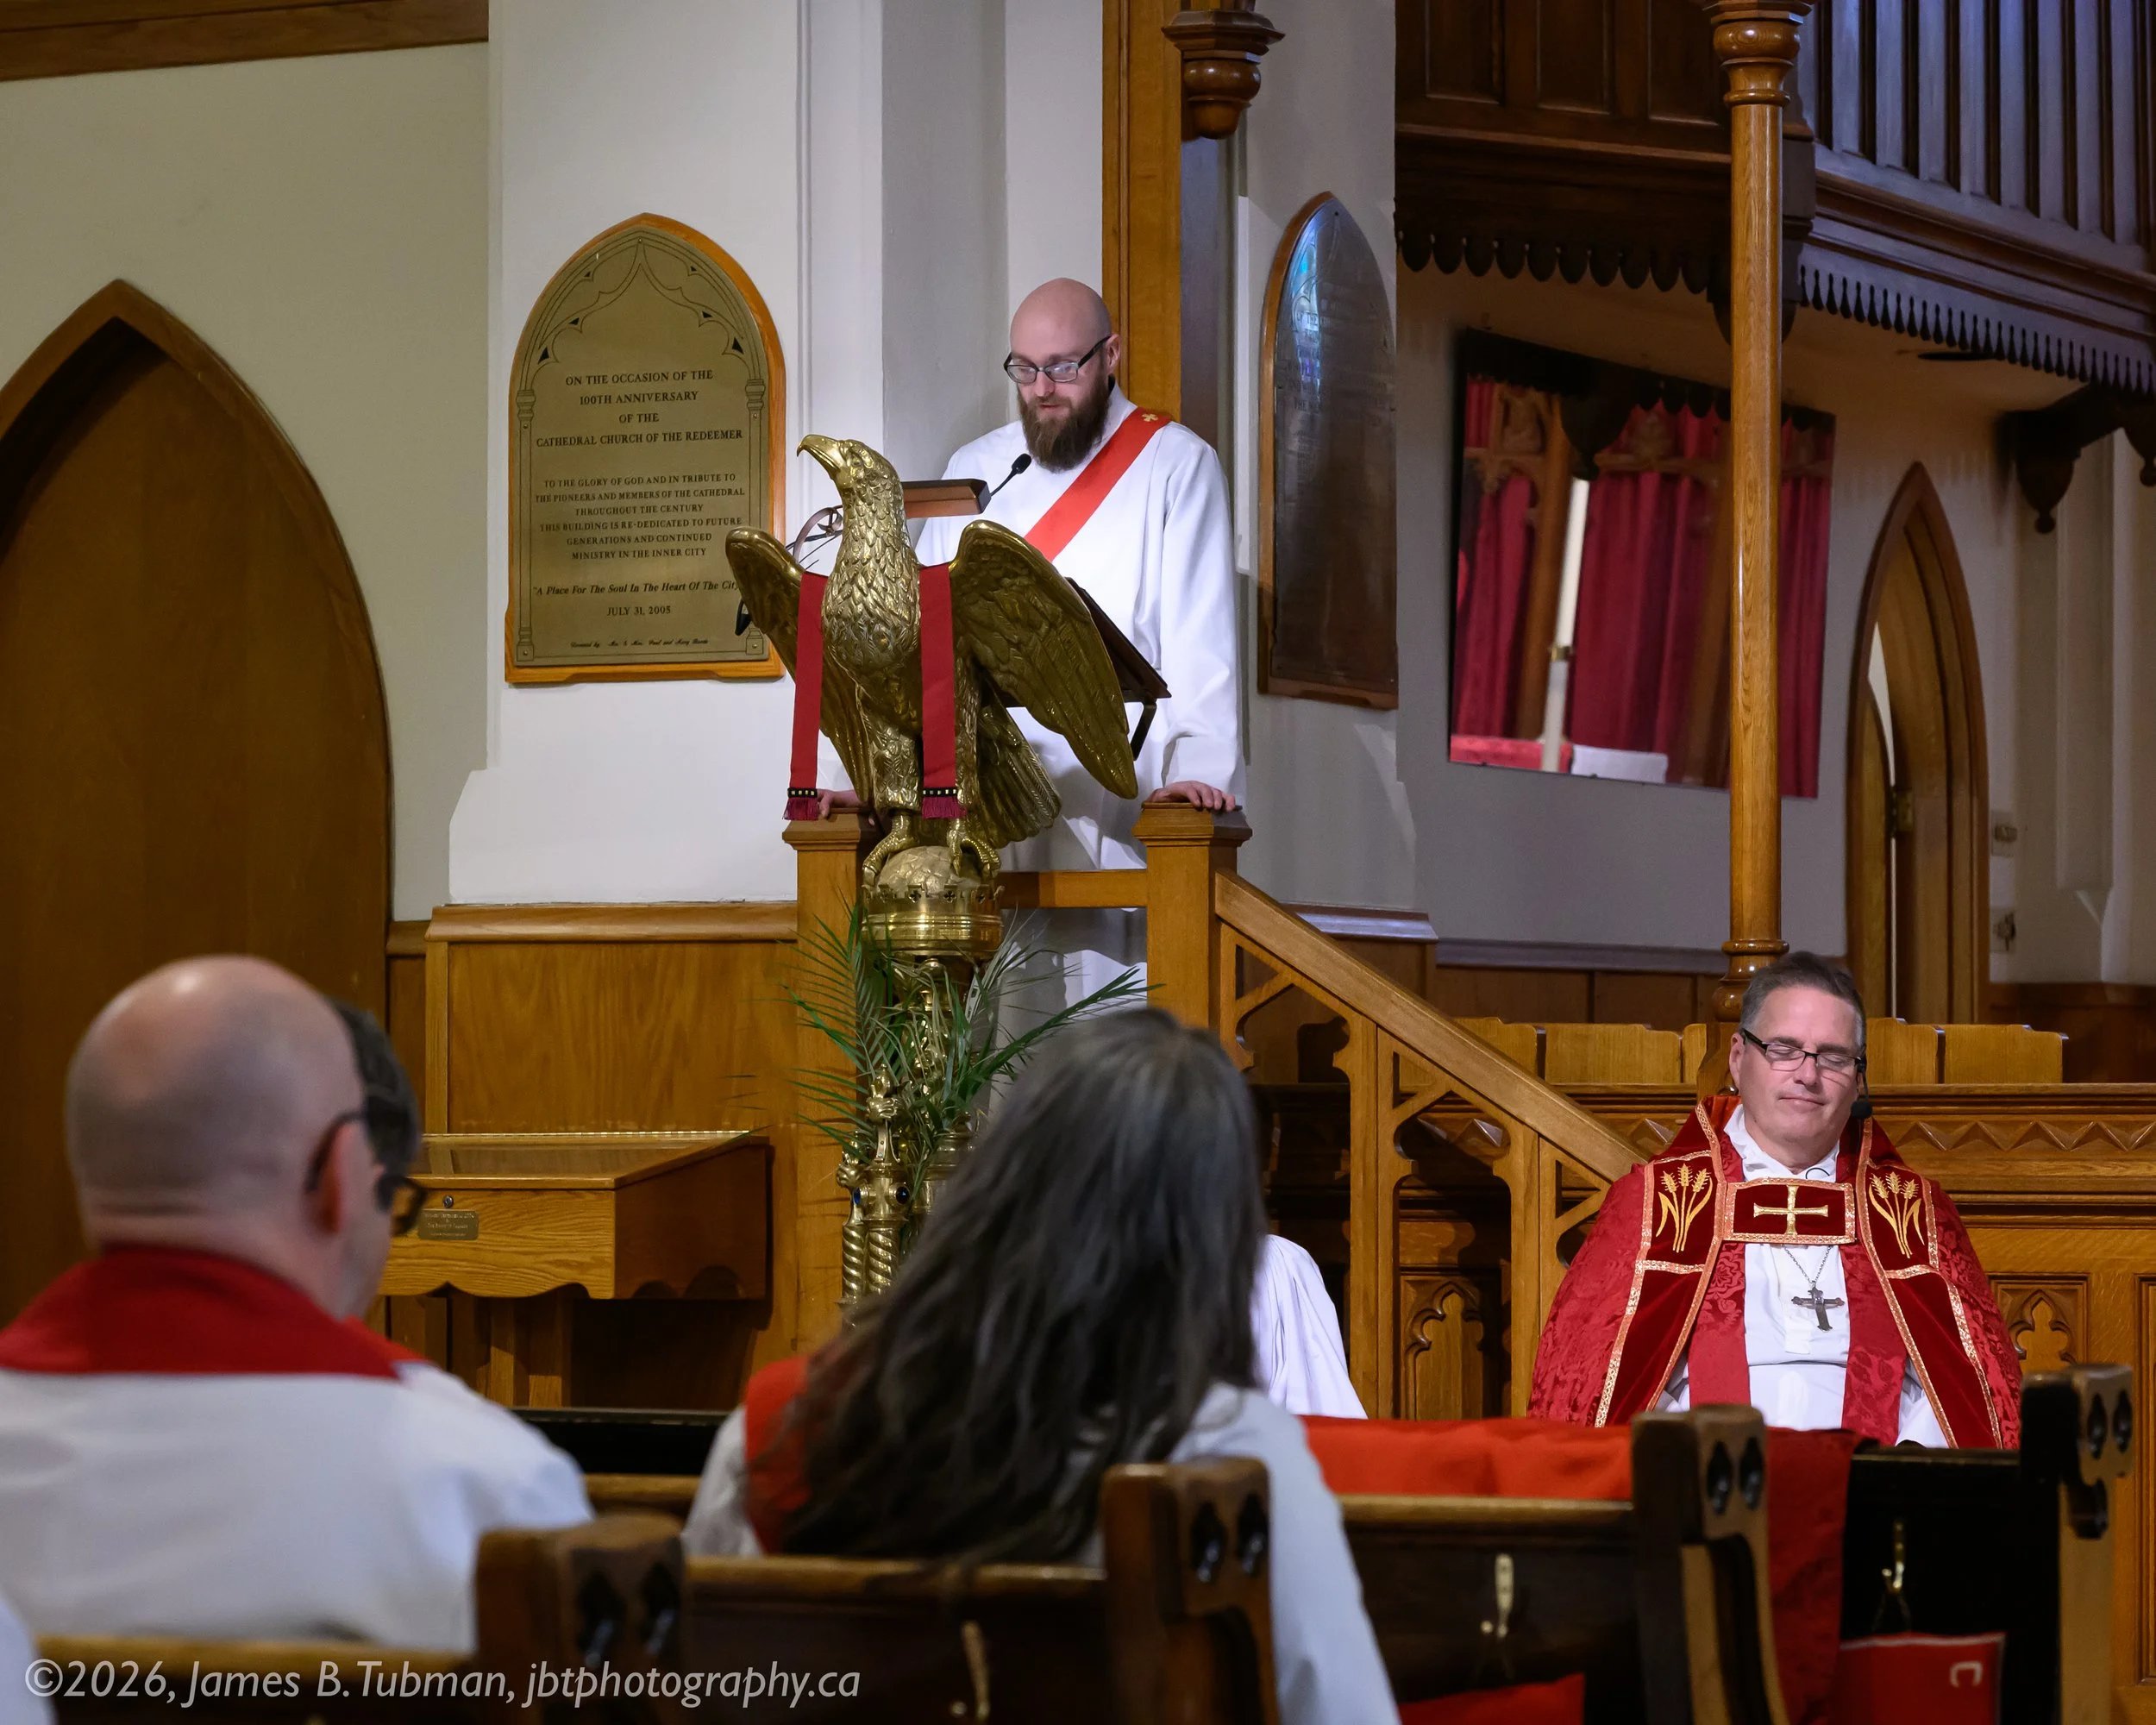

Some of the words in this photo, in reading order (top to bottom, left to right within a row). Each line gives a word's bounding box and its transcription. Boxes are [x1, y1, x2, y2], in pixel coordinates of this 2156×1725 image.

[566, 376, 582, 385] ON
[586, 374, 608, 384] THE
[611, 373, 669, 383] OCCASION
[673, 372, 687, 380] OF
[691, 370, 713, 380] THE
[580, 395, 611, 405] 100TH
[616, 391, 699, 404] ANNIVERSARY
[619, 414, 634, 423] OF
[636, 413, 659, 422] THE
[536, 435, 596, 447] CATHEDRAL
[600, 434, 642, 444] CHURCH
[647, 434, 659, 442] OF
[662, 432, 682, 442] THE
[686, 430, 743, 440] REDEEMER
[578, 479, 607, 487] GLORY
[682, 474, 721, 483] TRIBUTE
[554, 493, 595, 502] PIONEERS
[619, 491, 659, 500] MEMBERS
[693, 488, 744, 497] CATHEDRAL
[576, 507, 636, 516] THROUGHOUT
[563, 522, 608, 530] BUILDING
[621, 519, 689, 529] RE-DEDICATED
[567, 536, 631, 546] GENERATIONS
[656, 533, 711, 543] CONTINUED
[572, 551, 616, 560] MINISTRY
[653, 549, 682, 557] INNER
[546, 586, 568, 595] Place
[642, 583, 659, 592] The
[661, 582, 686, 591] Heart
[703, 581, 718, 590] The
[607, 607, 630, 616] JULY
